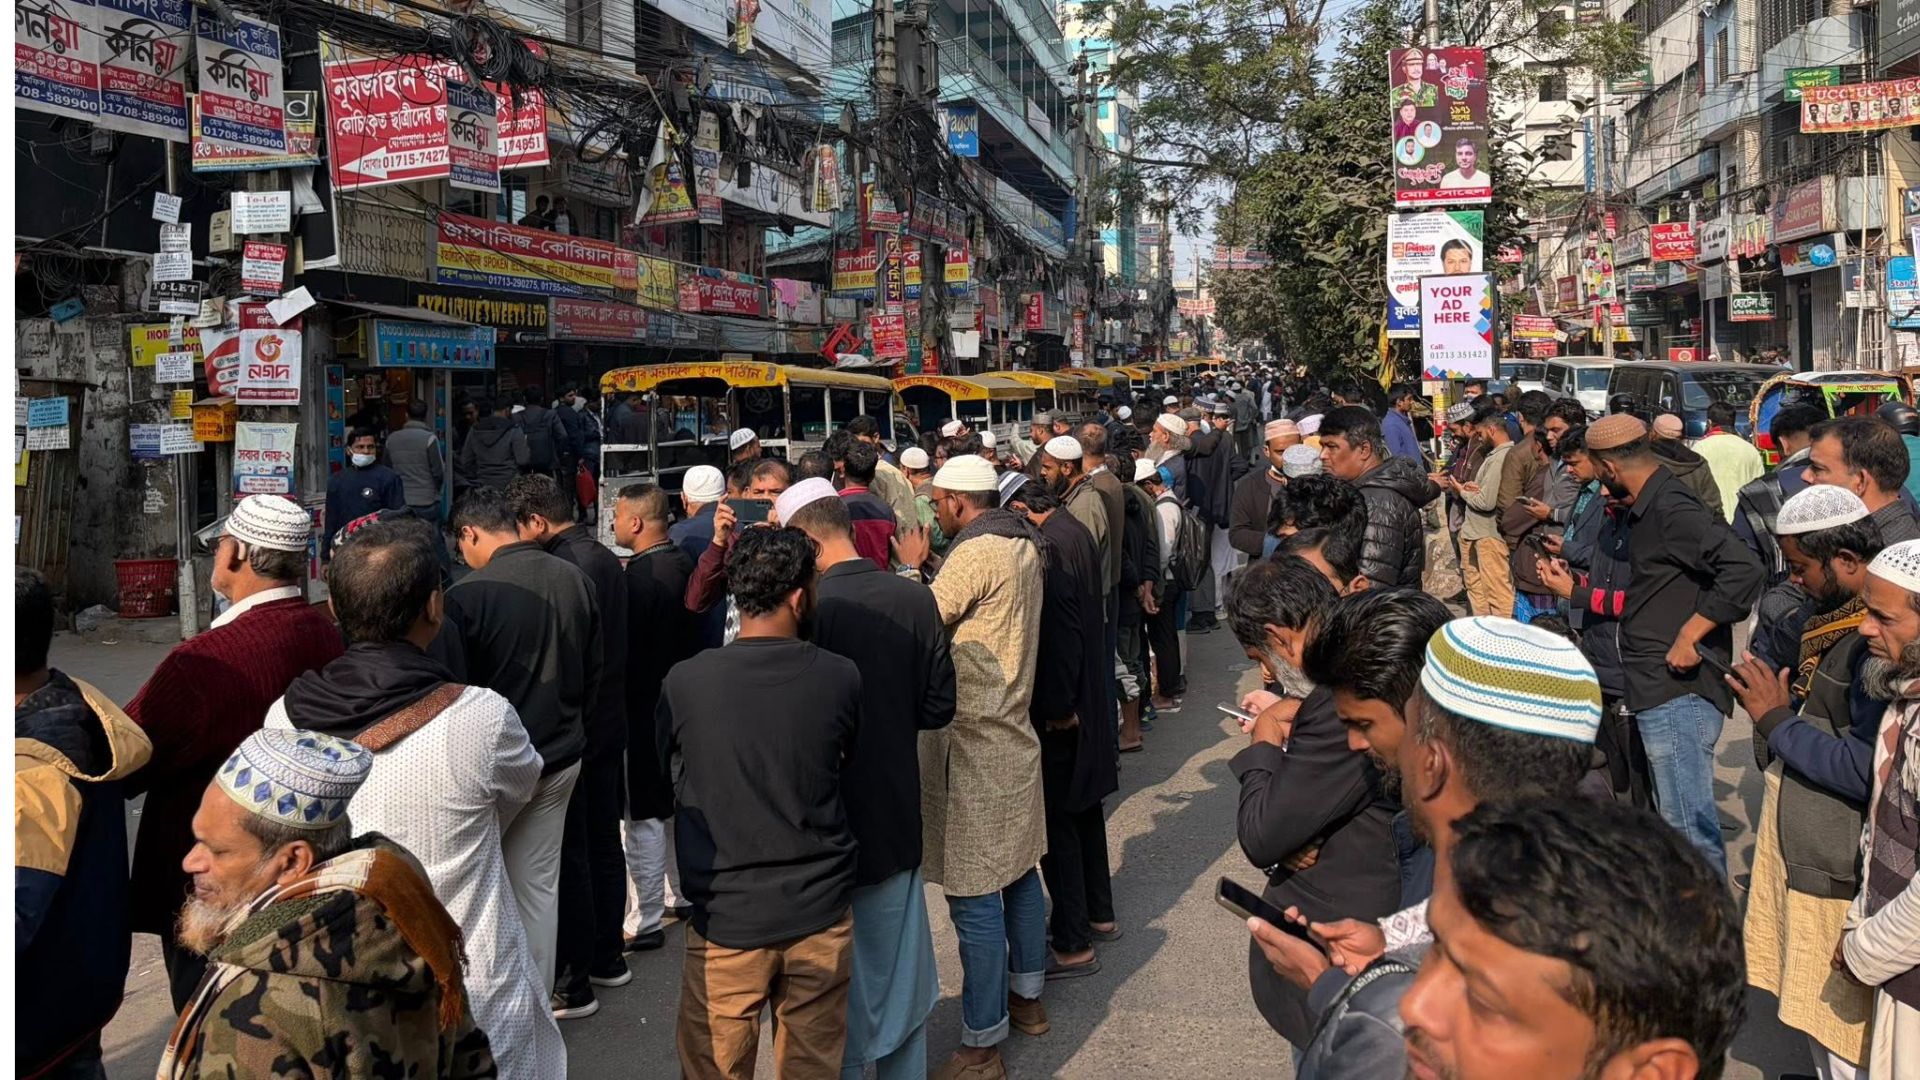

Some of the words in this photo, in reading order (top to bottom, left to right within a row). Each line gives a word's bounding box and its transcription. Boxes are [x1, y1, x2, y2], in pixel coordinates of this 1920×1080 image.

[331, 67, 418, 111] নূরজাহান
[390, 102, 432, 131] ছাত্রীদের
[434, 104, 448, 123] জ
[1450, 105, 1471, 115] ১৯৭১
[203, 126, 284, 148] 01708-589900
[244, 195, 280, 204] To-Let
[1430, 286, 1472, 299] YOUR
[1441, 299, 1462, 311] AD
[528, 303, 547, 326] LTD
[1394, 305, 1420, 320] মুনত
[1433, 312, 1471, 324] HERE
[877, 316, 897, 326] VIP
[1430, 351, 1455, 360] 01713
[1456, 350, 1488, 359] 351423
[248, 365, 290, 379] নগদ
[725, 364, 762, 379] পাঠান
[238, 449, 260, 462] সবার
[261, 450, 292, 464] দোয়া-২
